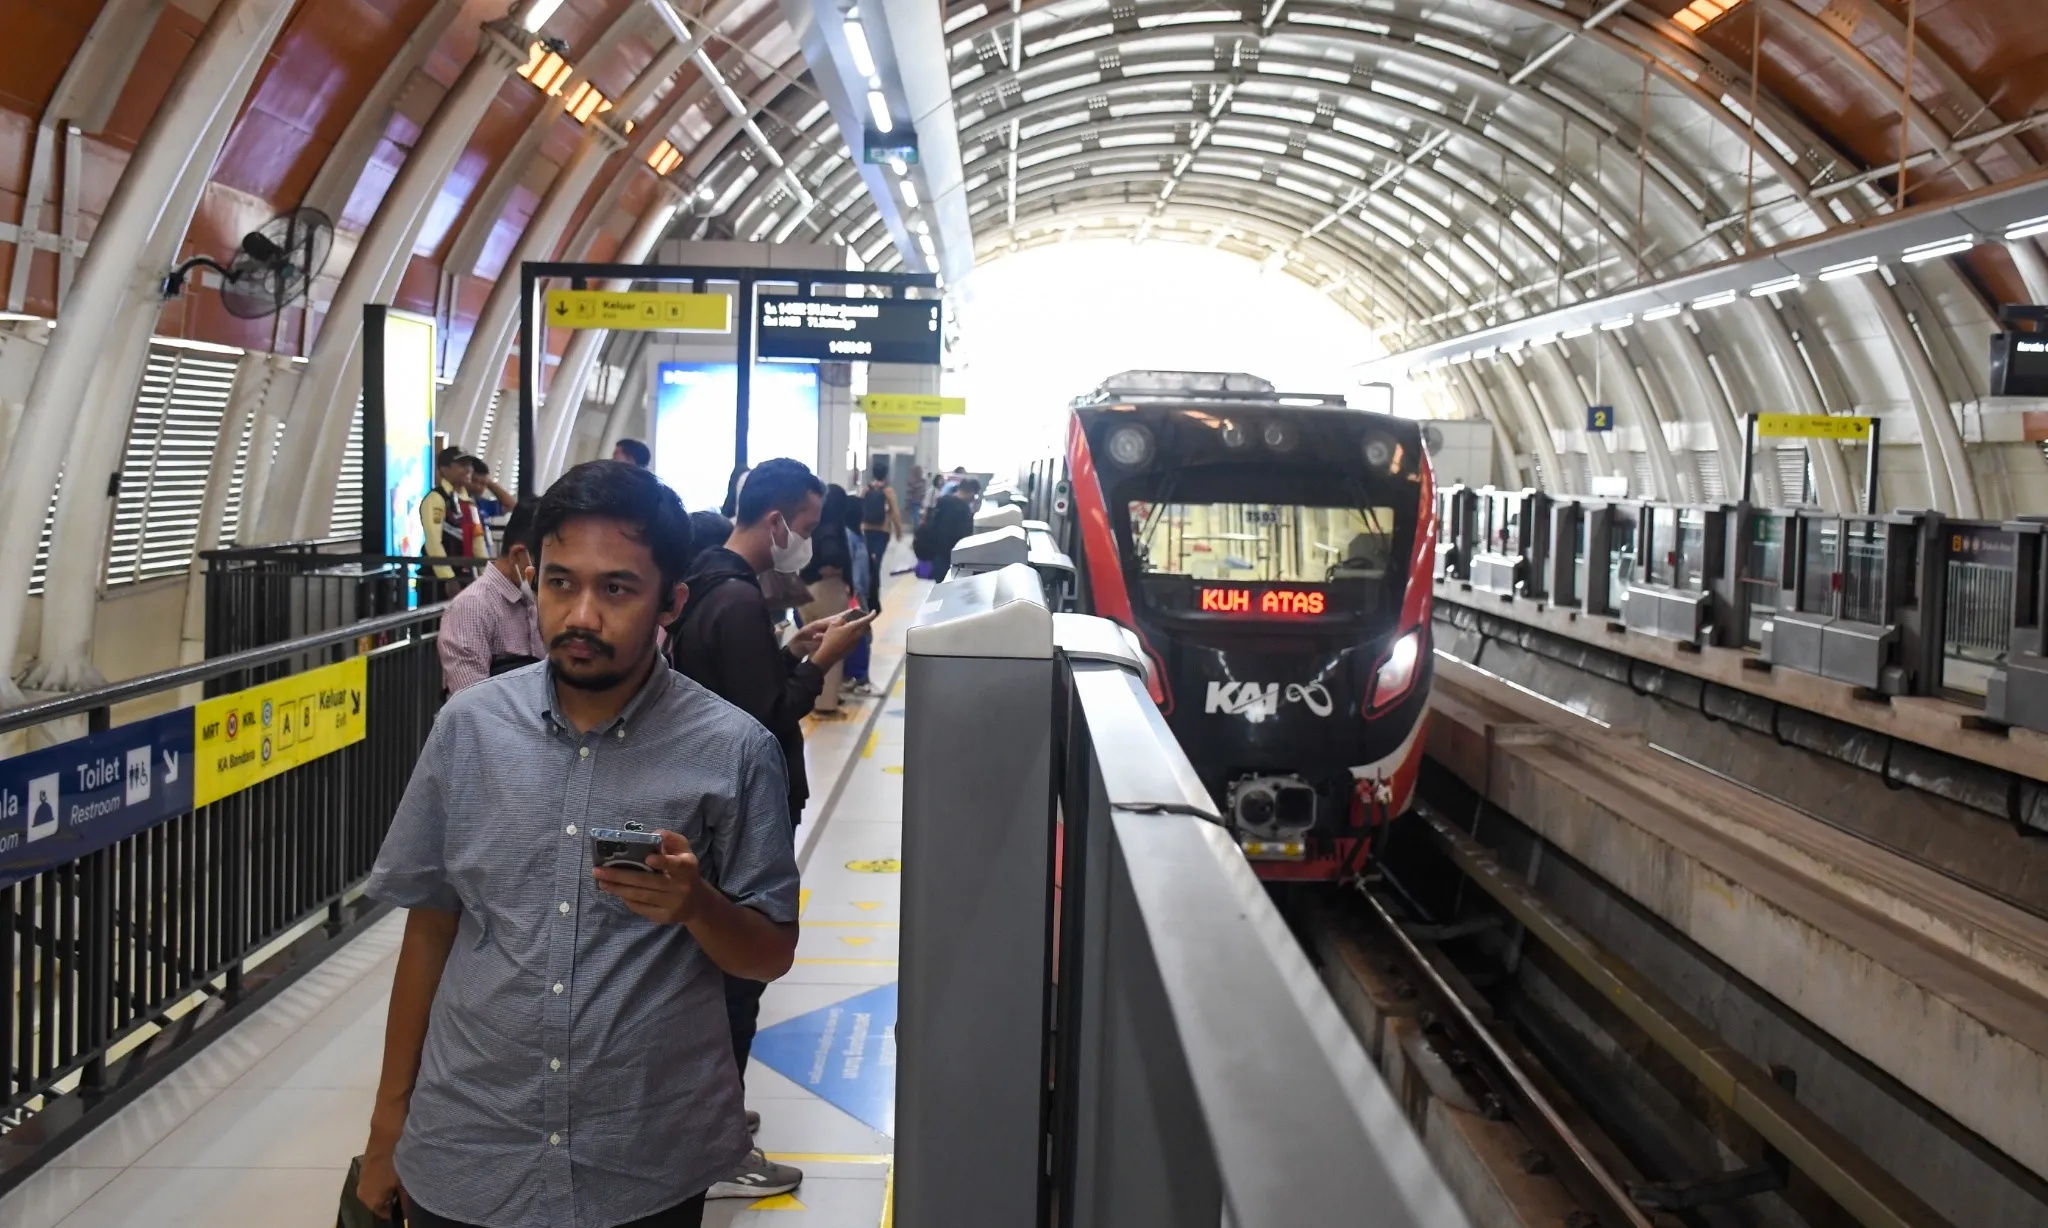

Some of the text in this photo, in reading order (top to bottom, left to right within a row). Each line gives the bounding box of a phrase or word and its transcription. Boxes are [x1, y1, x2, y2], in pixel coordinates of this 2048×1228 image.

[603, 301, 678, 316] Keluar A B
[1594, 411, 1606, 427] 2
[1202, 588, 1325, 614] KUH ATAS
[319, 688, 347, 711] Keluar
[1205, 681, 1279, 715] KAI
[202, 722, 220, 741] MRT
[242, 711, 256, 727] KRL
[283, 714, 291, 735] A
[303, 706, 310, 728] B
[77, 757, 120, 791] Toilet
[217, 749, 255, 773] KA Bandara
[70, 795, 120, 826] Restroom
